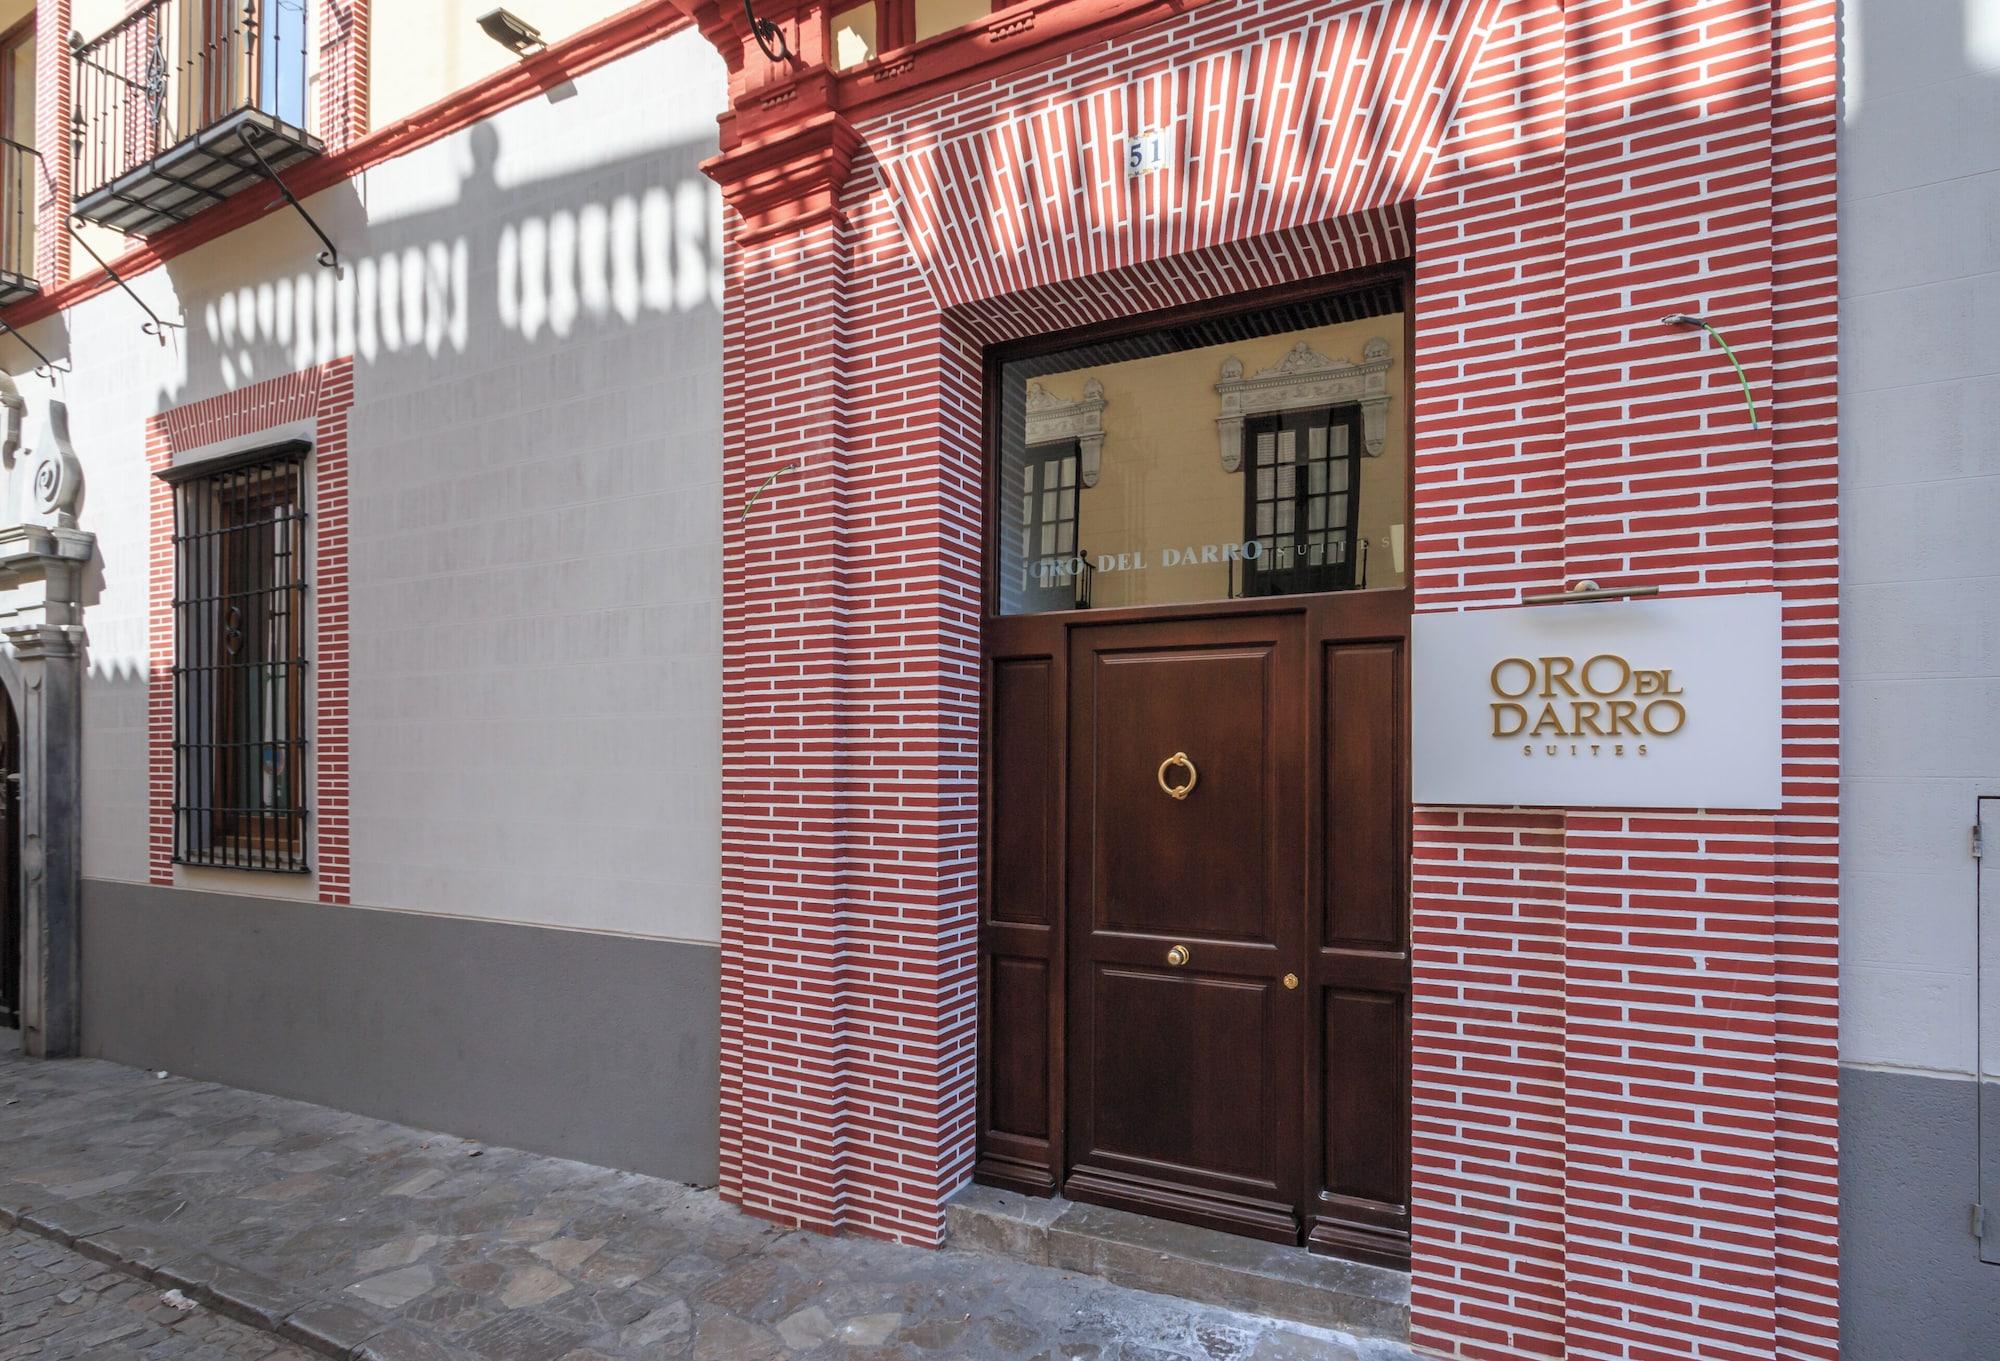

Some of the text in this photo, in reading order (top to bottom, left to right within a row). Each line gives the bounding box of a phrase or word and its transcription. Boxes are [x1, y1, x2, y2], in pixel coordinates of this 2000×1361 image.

[1129, 138, 1161, 168] 51
[1029, 536, 1390, 579] ORO DEL DARRO SUITES
[1490, 654, 1631, 697] ORO
[1490, 699, 1686, 737] DARRO
[1523, 744, 1648, 756] SUITES
